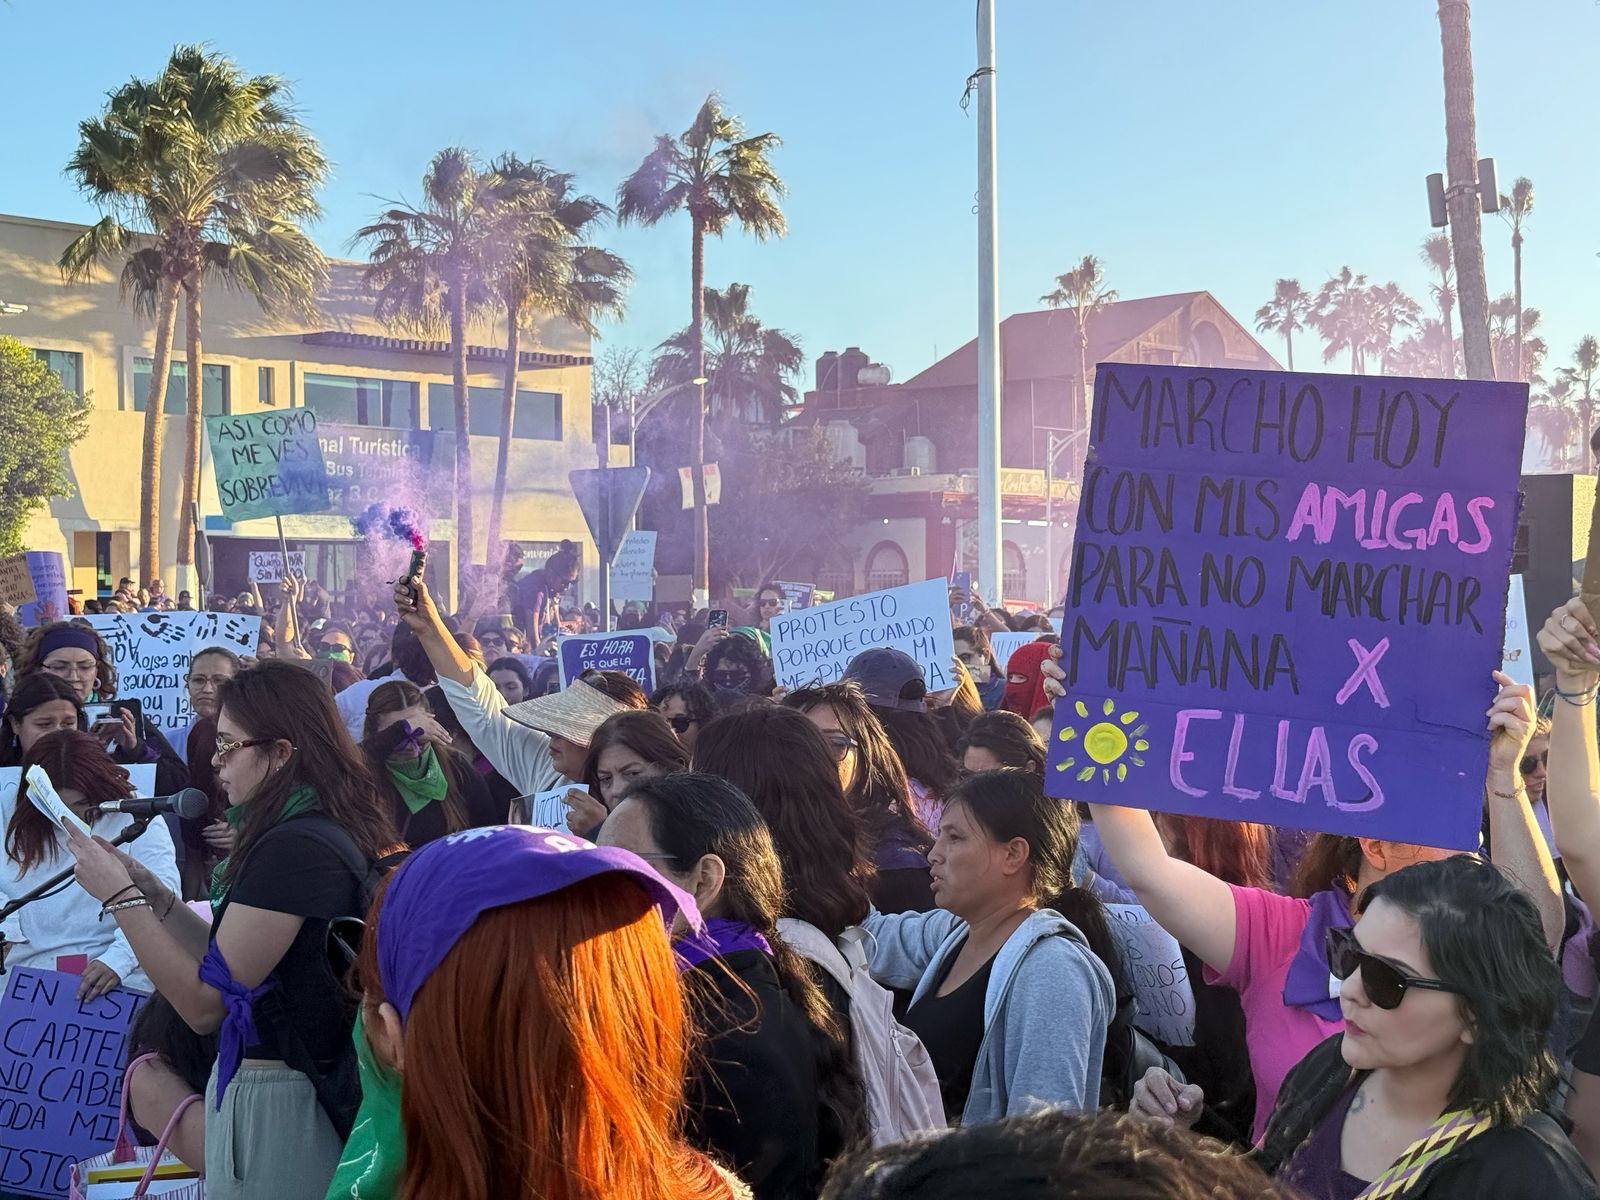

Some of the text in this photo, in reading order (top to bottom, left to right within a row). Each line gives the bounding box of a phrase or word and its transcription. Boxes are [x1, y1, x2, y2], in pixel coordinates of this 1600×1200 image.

[218, 410, 317, 443] ASI COMO
[1100, 371, 1460, 469] MARCHO HOY
[231, 438, 310, 466] ME VES
[348, 436, 421, 458] Turística
[326, 461, 354, 477] Bus
[1084, 466, 1495, 553] CON MIS AMIGAS
[1072, 541, 1483, 635] PARA NO MARCHAR
[778, 594, 897, 643] PROTESTO
[580, 640, 634, 658] ES HORA
[777, 616, 935, 671] PORQUE CUANDO
[912, 636, 937, 660] MI
[131, 652, 169, 673] estoy
[583, 660, 596, 669] DE
[1070, 616, 1390, 709] MAÑANA X
[123, 673, 179, 692] razones
[142, 696, 163, 710] no
[1169, 708, 1385, 812] ELLAS
[11, 973, 60, 1006] EN
[4, 1018, 126, 1070] CARTEL
[0, 1060, 34, 1090] NO
[69, 1111, 119, 1142] MI
